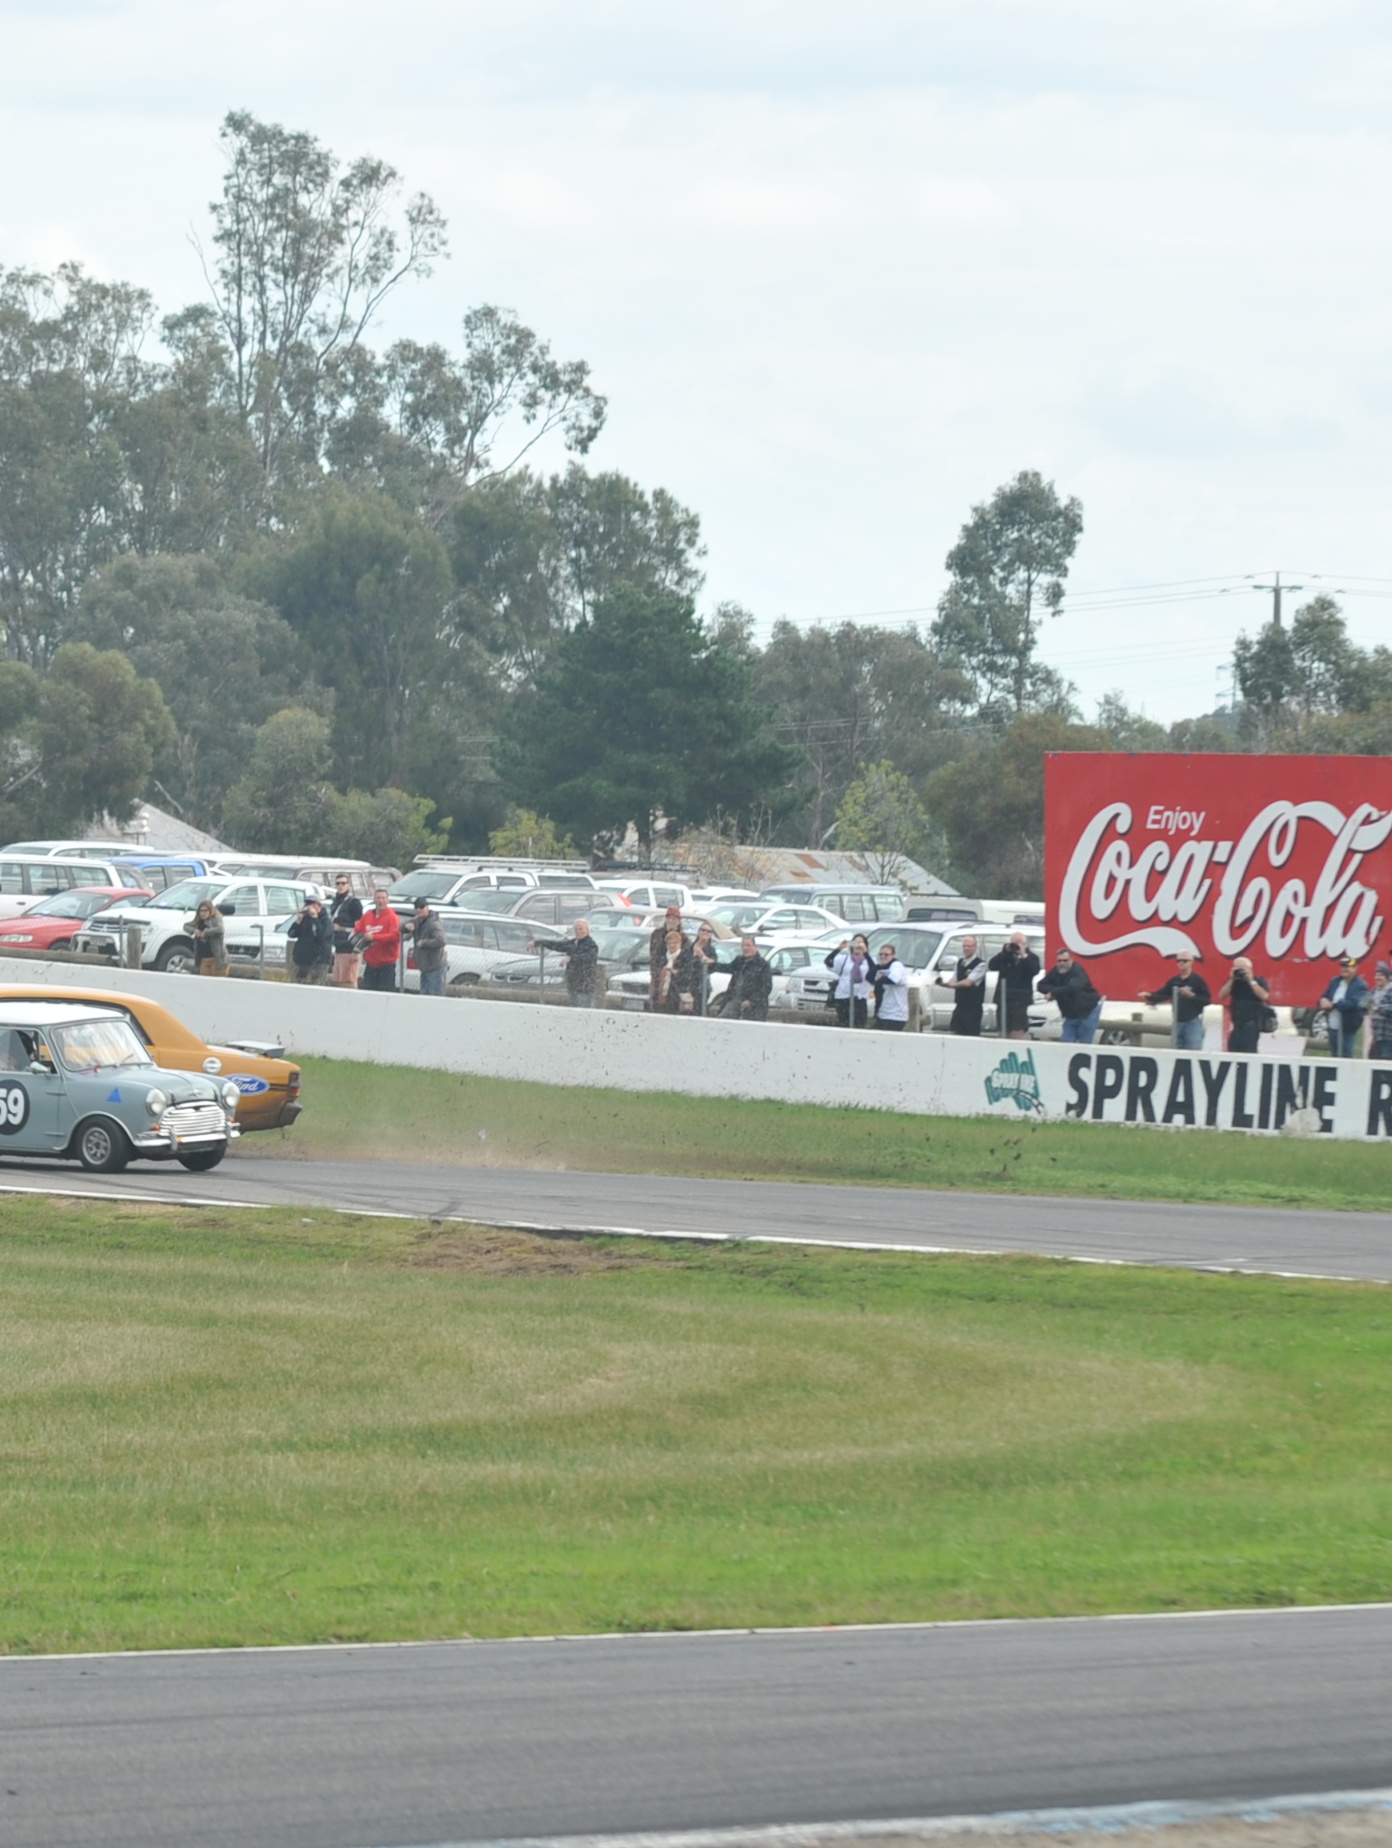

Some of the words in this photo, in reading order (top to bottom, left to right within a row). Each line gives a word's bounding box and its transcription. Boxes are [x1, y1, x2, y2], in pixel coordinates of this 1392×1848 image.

[1146, 804, 1206, 836] Enjoy
[1058, 799, 1392, 959] Coca-Cola
[1065, 1052, 1338, 1133] SPRAYLINE
